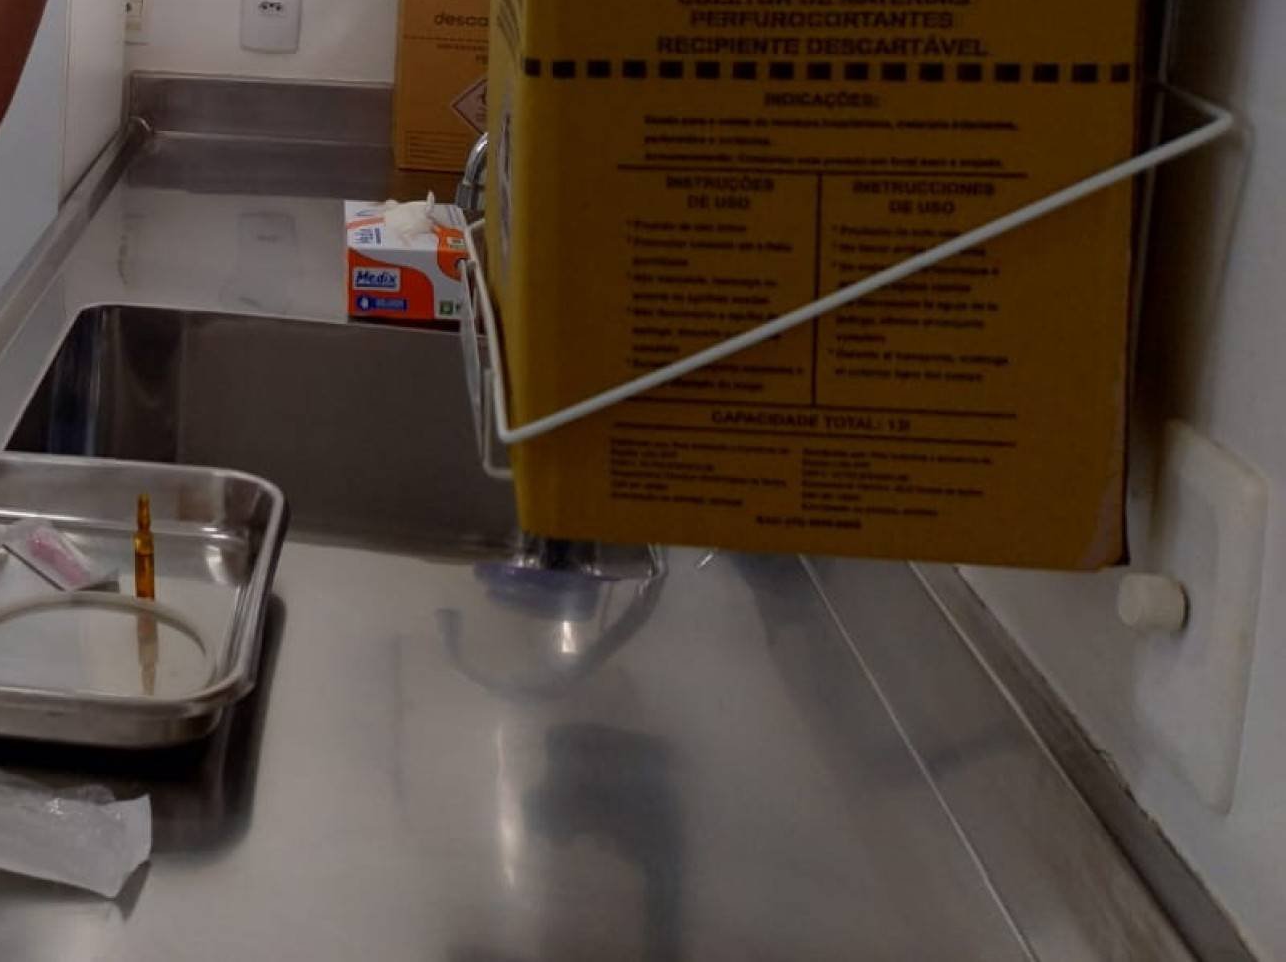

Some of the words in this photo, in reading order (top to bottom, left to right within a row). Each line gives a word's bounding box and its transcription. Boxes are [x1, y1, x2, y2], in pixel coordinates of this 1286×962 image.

[690, 11, 954, 29] PERFUROCORTANTES
[657, 36, 799, 55] RECIPIENTE
[806, 34, 989, 56] DESCARTÁVEL
[764, 91, 881, 108] INDICAÇÕES:
[666, 176, 775, 193] INSTRUÇÕES
[852, 180, 996, 197] INSTRUCCIONES
[687, 194, 708, 210] DE
[715, 194, 751, 210] USO
[888, 200, 913, 215] DE
[918, 200, 955, 215] USO
[355, 269, 397, 284] Medix
[711, 410, 819, 428] CAPACIDADE
